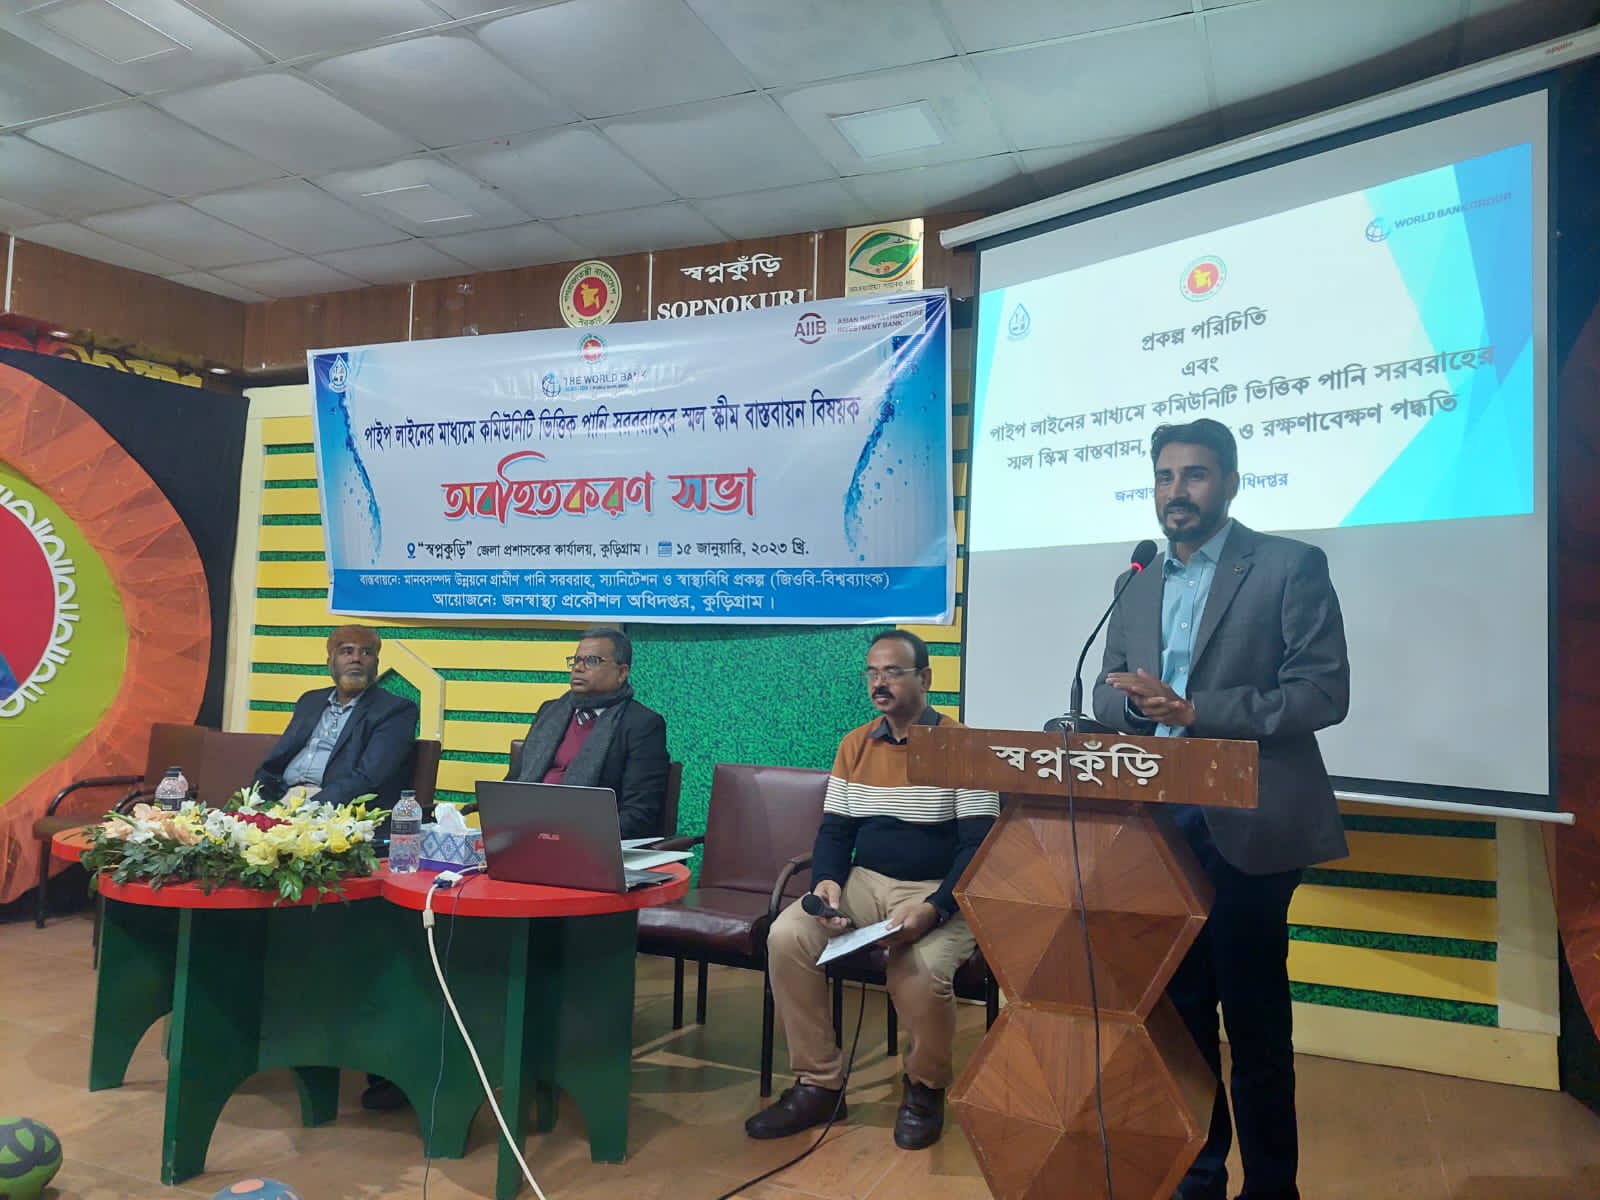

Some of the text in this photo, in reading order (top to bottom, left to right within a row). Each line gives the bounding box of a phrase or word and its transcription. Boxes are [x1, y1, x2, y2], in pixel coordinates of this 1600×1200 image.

[1394, 211, 1436, 229] WORLD
[1437, 202, 1466, 219] BANK
[680, 253, 783, 284] স্বপ্নকুঁড়ি
[656, 288, 808, 321] SOPNOKURI
[794, 319, 827, 337] AIIB
[1142, 307, 1268, 351] প্রকল্প পরিচিতি
[1182, 357, 1219, 377] এবং
[990, 346, 1496, 442] পাইপ লাইনের মাধ্যমে কমিউনিটি ভিত্তিক পানি সরবরাহের
[364, 418, 392, 451] পাইপ
[395, 415, 434, 449] লাইনের
[438, 420, 476, 446] মাধ্যমে
[479, 410, 535, 443] কমিউনিটি
[539, 407, 578, 440] ভিত্তিক
[582, 405, 609, 439] পানি
[744, 396, 806, 430] বাস্তবায়ন
[810, 388, 861, 426] বিষয়ক
[1008, 389, 1460, 471] স্মল স্কিম বাস্তবায়ন, ও রক্ষণাবেক্ষণ পদ্ধতি
[441, 450, 757, 526] অবহিতকরণ সভা
[477, 543, 500, 557] জেলা
[504, 543, 550, 557] প্রশাসকের
[600, 540, 642, 558] কুড়িগ্রাম
[676, 544, 692, 556] ১৫
[751, 543, 788, 556] ২০২৩
[404, 574, 451, 587] মানবসম্পদ
[455, 571, 487, 588] উন্নয়নে
[490, 570, 520, 587] গ্রামীণ
[523, 571, 546, 587] পানি
[600, 570, 658, 587] স্যানিটেশন
[663, 575, 672, 586] ও
[676, 570, 729, 589] স্বাস্থ্যবিধি
[733, 573, 766, 587] প্রকল্প
[502, 593, 557, 611] জনস্বাস্থ্য
[561, 591, 622, 608] প্রকৌশল
[702, 591, 764, 611] কুড়িগ্রাম
[988, 741, 1164, 786] স্বপ্নকুঁড়ি
